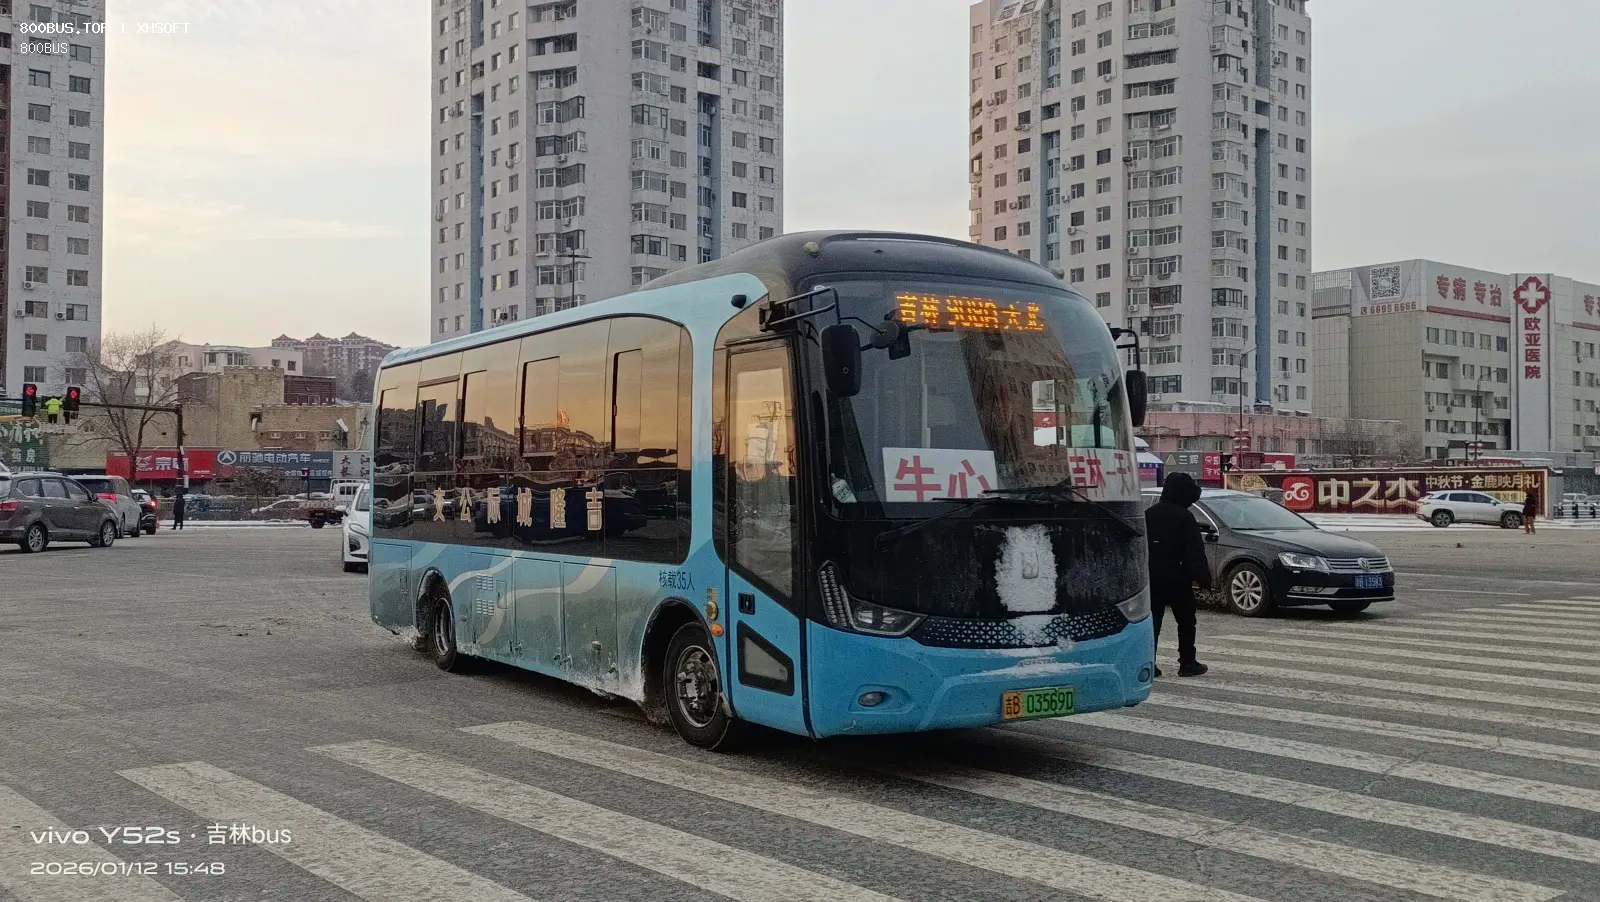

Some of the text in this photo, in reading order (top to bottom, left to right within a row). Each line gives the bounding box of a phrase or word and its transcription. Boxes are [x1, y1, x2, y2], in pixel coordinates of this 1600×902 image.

[1524, 316, 1542, 379] 欧亚医院
[239, 452, 311, 463] 丽驰电动汽车
[893, 455, 993, 502] 牛心
[658, 570, 696, 591] 核载35人
